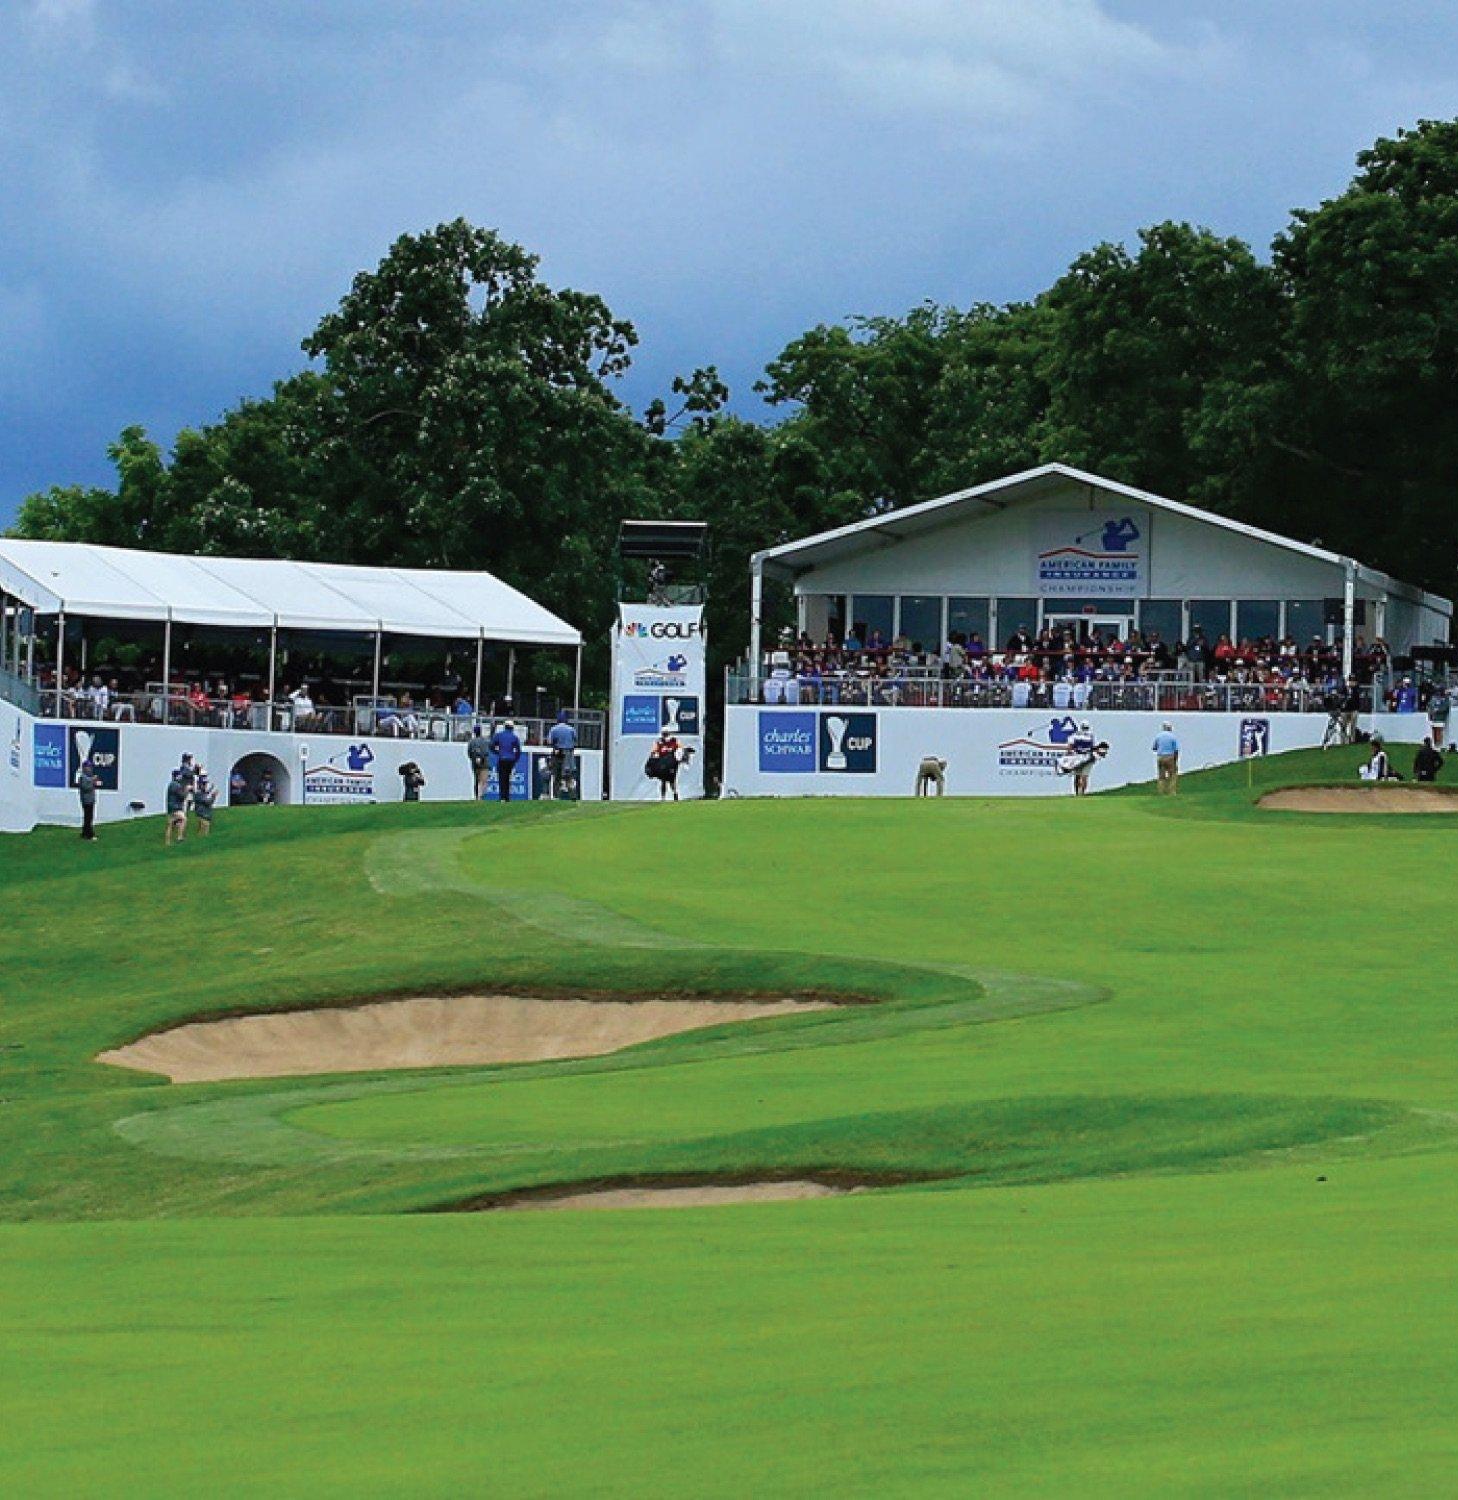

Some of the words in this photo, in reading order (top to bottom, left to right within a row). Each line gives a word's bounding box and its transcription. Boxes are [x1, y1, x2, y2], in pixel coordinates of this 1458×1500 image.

[1040, 561, 1096, 569] AMERICAN
[1098, 561, 1137, 569] FAMILY
[1044, 571, 1132, 579] INSURANCE
[1040, 585, 1137, 593] CHAMPIONSHIP
[651, 622, 698, 638] GOLF
[763, 728, 812, 743] charles
[847, 736, 873, 750] CUP
[764, 745, 812, 754] SCHWAB
[92, 752, 117, 767] CUP
